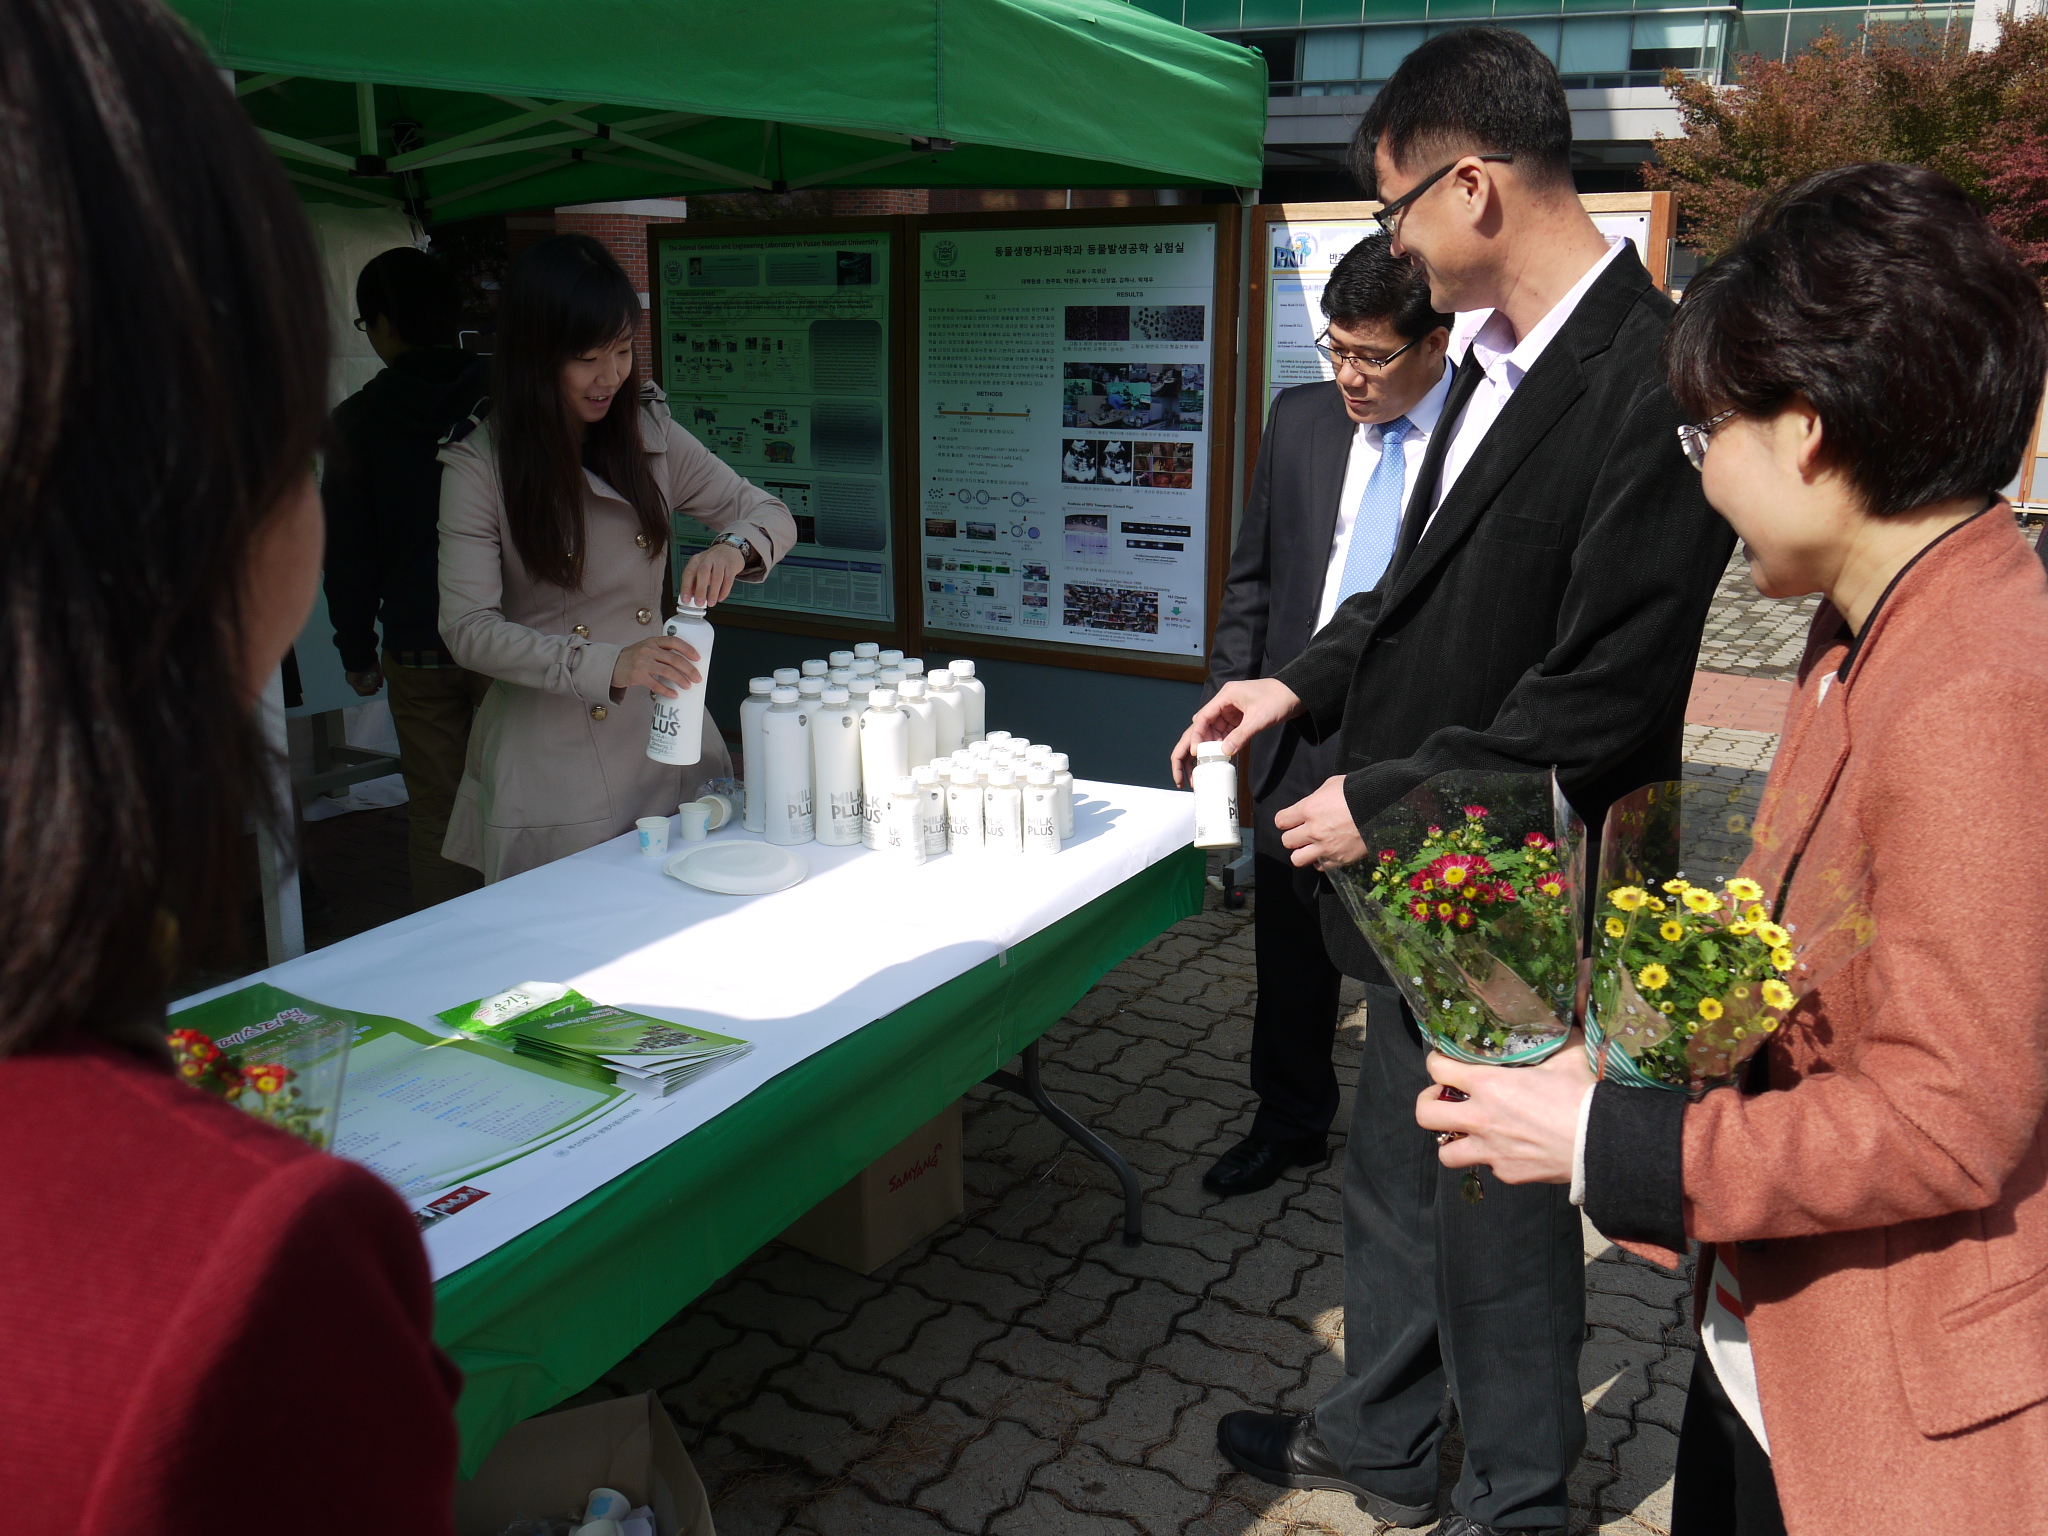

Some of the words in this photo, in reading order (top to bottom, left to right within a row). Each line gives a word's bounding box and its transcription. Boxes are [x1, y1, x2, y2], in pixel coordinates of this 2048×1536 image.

[697, 243, 720, 251] Genetics
[720, 242, 732, 250] and
[732, 241, 765, 251] Engineering
[765, 241, 796, 250] Laboratory
[803, 239, 821, 247] Pusan
[822, 238, 847, 247] National
[848, 238, 879, 247] University
[1152, 241, 1185, 255] 실험실
[925, 269, 967, 279] 부산대학교
[1027, 816, 1053, 827] MILK
[888, 1154, 939, 1194] SAMYANG
